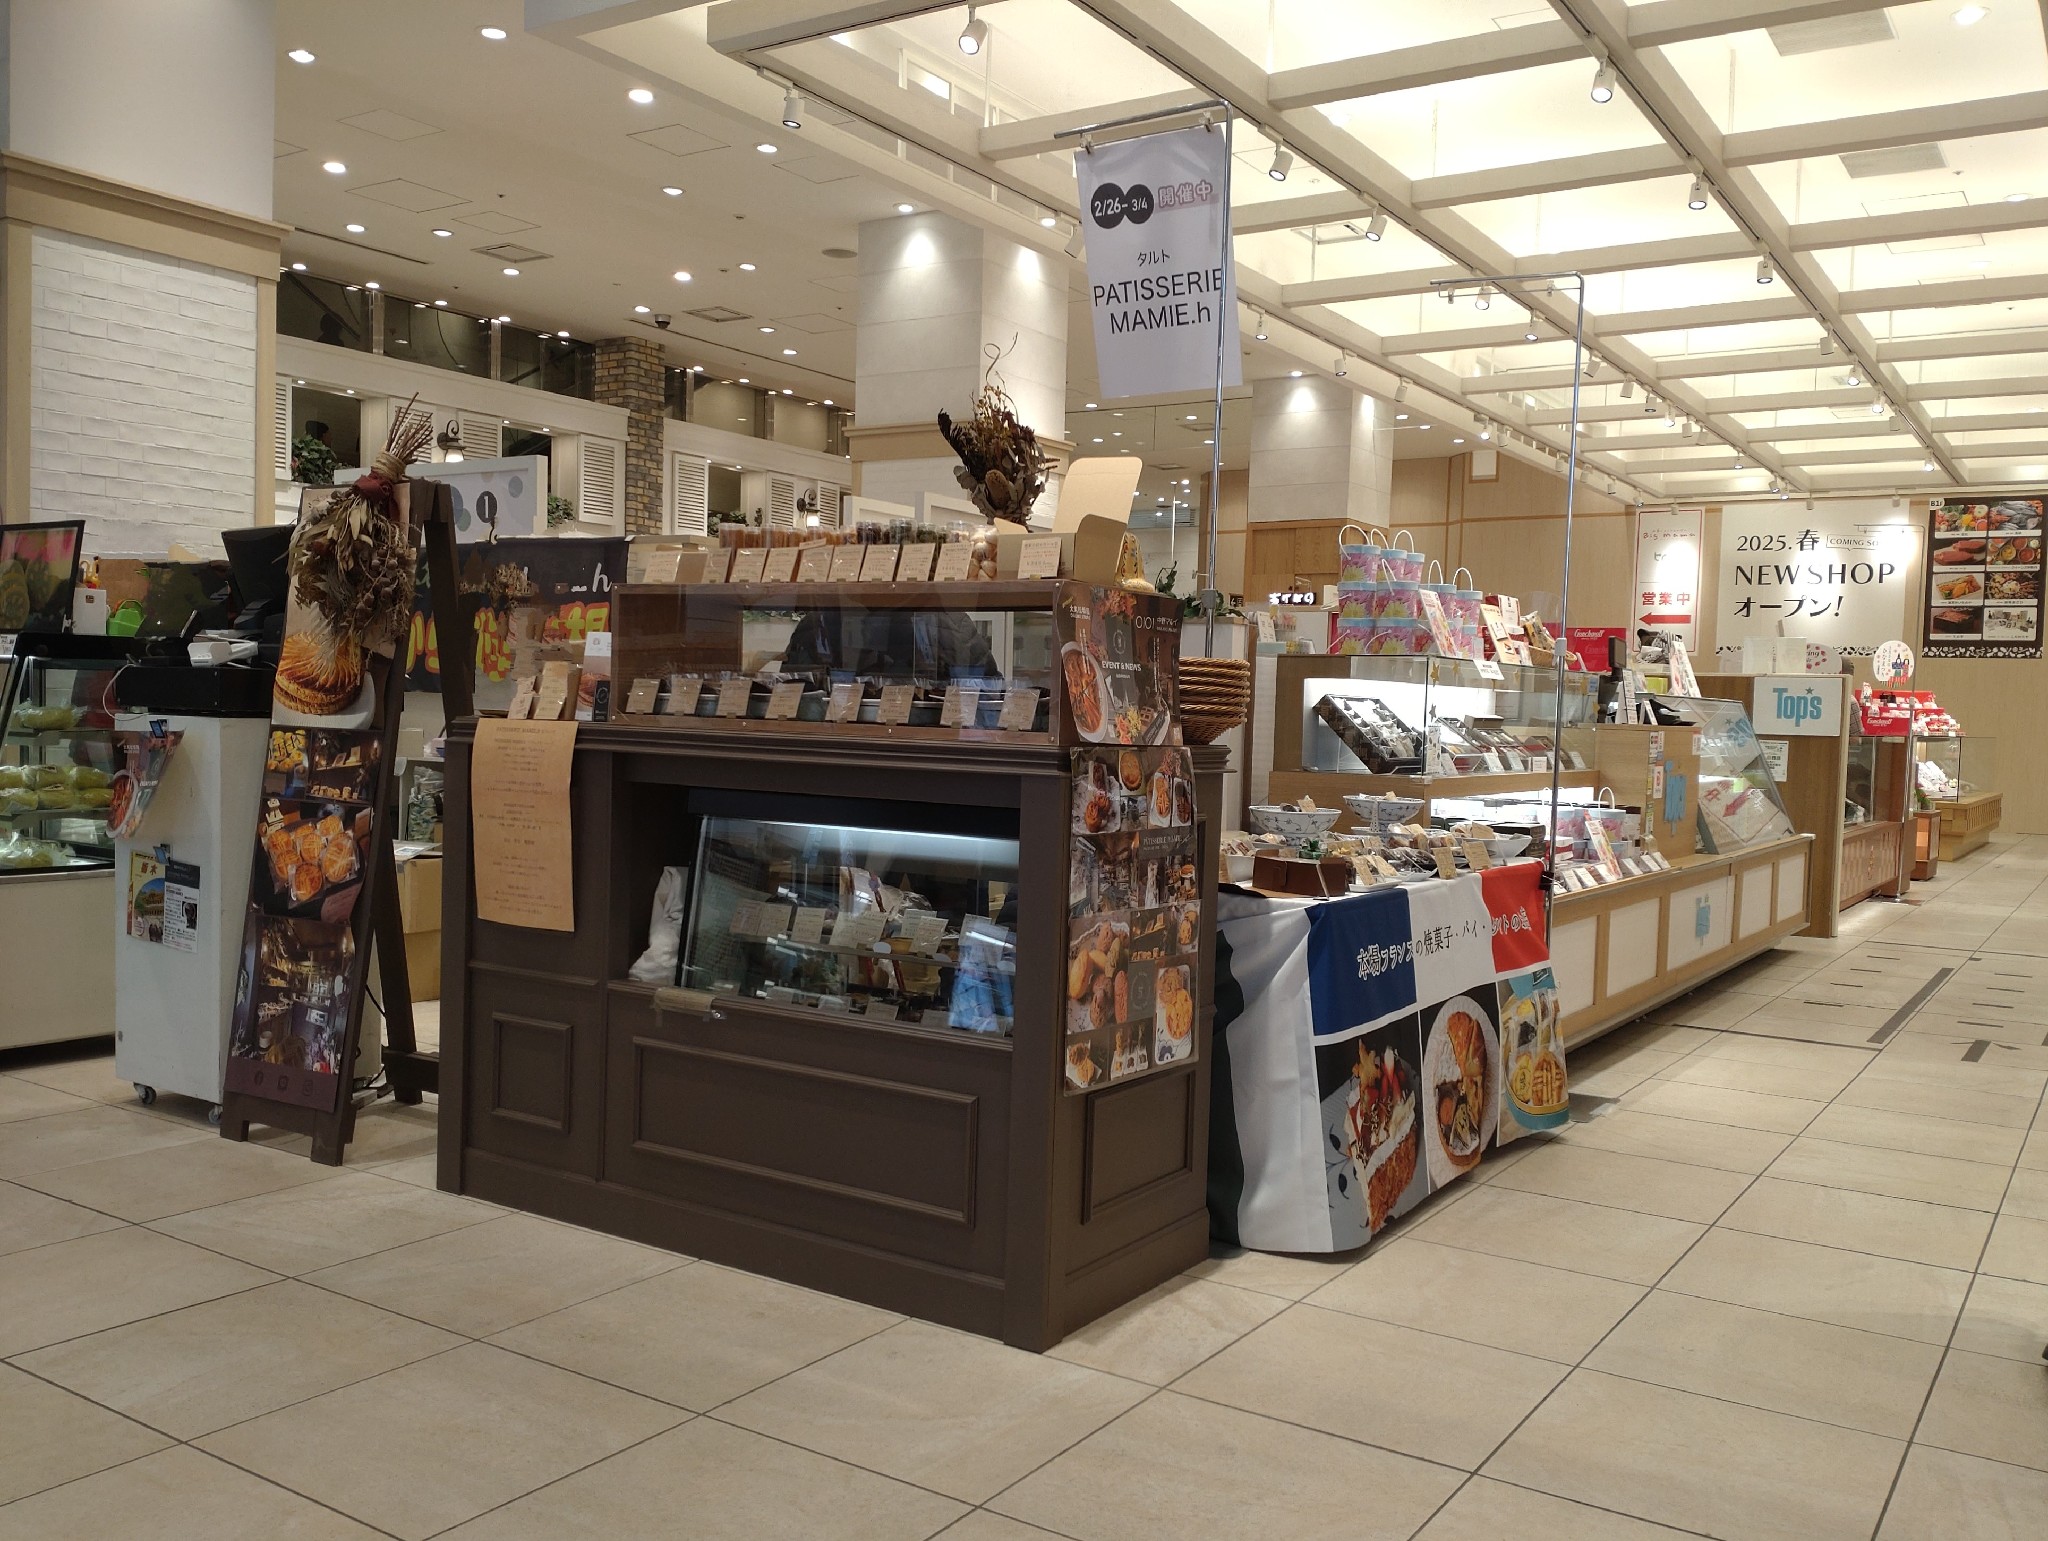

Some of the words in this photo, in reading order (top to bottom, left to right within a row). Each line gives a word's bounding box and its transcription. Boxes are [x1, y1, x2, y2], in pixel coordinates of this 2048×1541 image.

[1158, 181, 1213, 208] 開催中
[1137, 249, 1171, 267] タルト
[1093, 268, 1224, 306] PATISSERIE
[1110, 302, 1211, 334] MAMIE.h
[1829, 538, 1865, 546] COMING
[1735, 564, 1800, 586] NEW
[1806, 562, 1896, 585] SHOP
[1642, 592, 1690, 605] 営業中
[1733, 594, 1844, 618] オープン!
